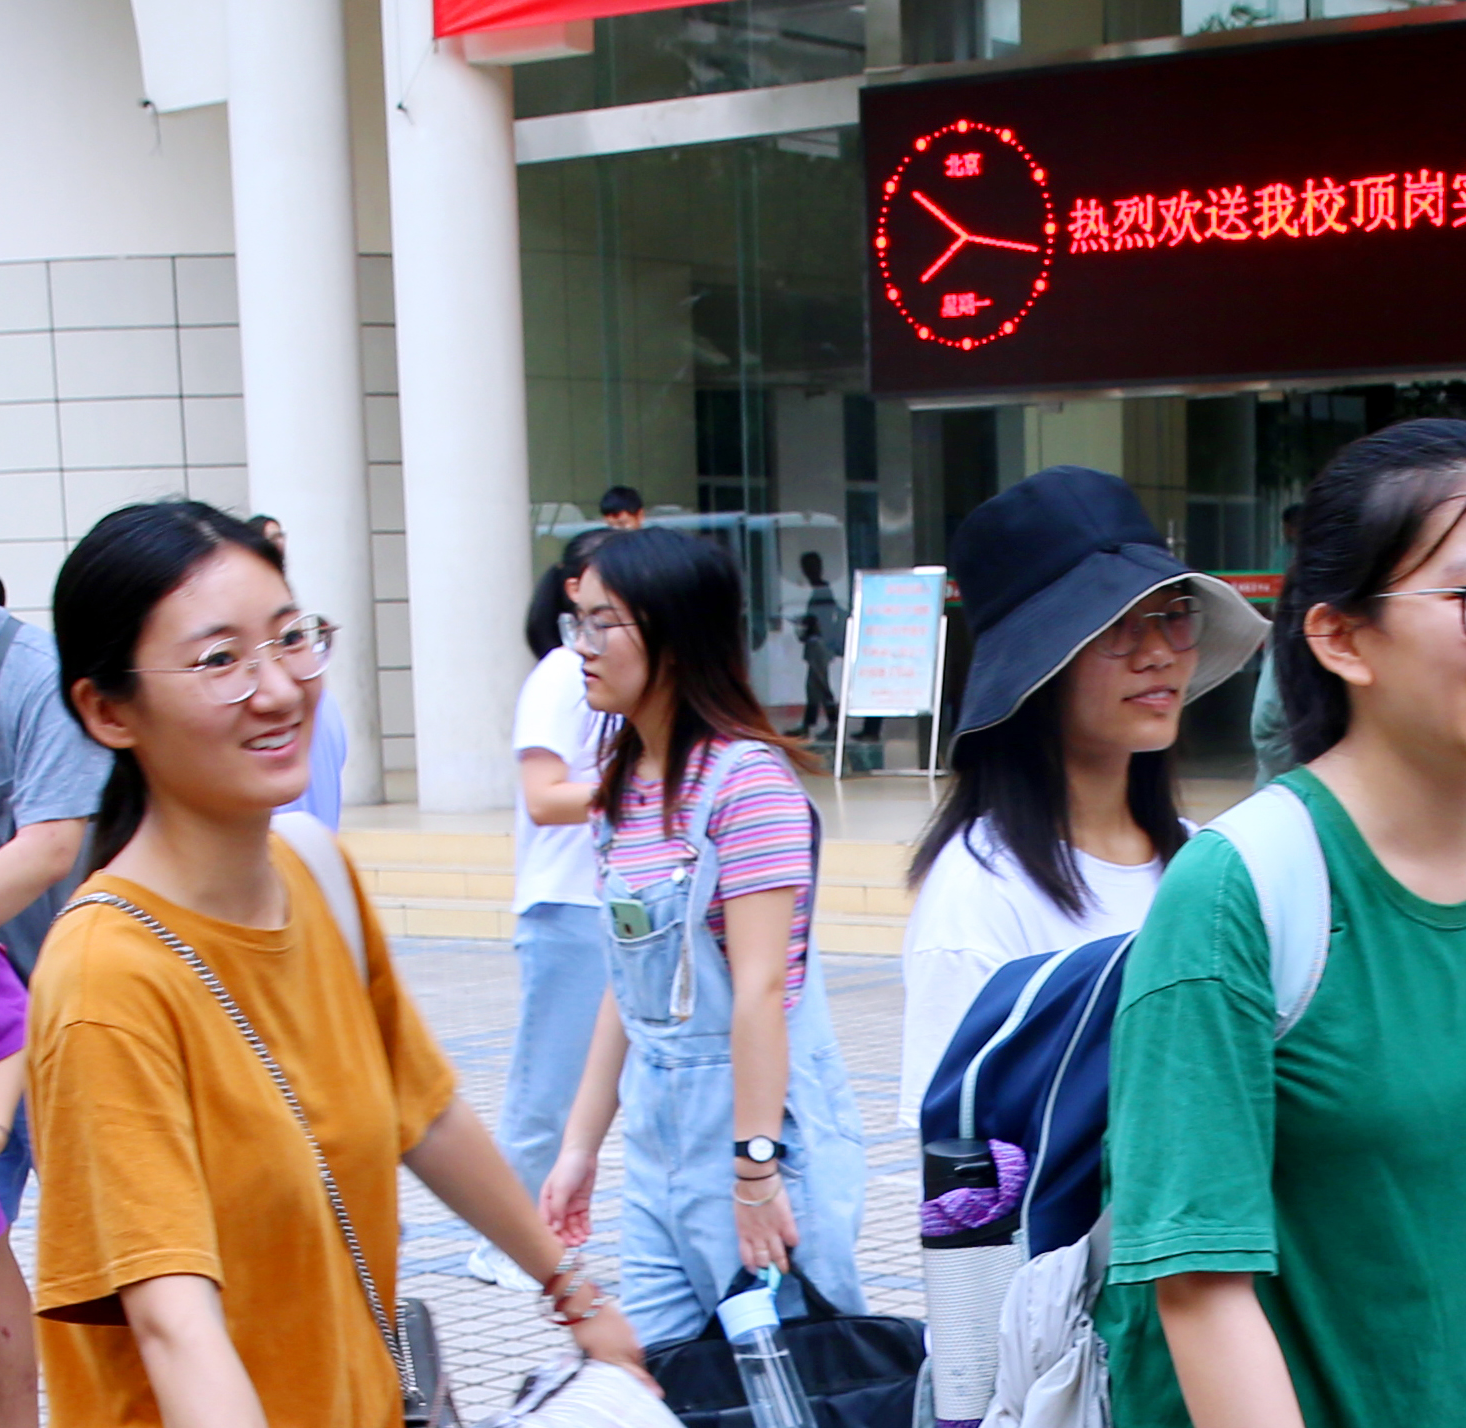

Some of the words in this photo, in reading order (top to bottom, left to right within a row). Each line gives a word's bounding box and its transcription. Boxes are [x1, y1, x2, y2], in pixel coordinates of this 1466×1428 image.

[944, 152, 982, 178] 北京
[940, 292, 993, 319] 星期一
